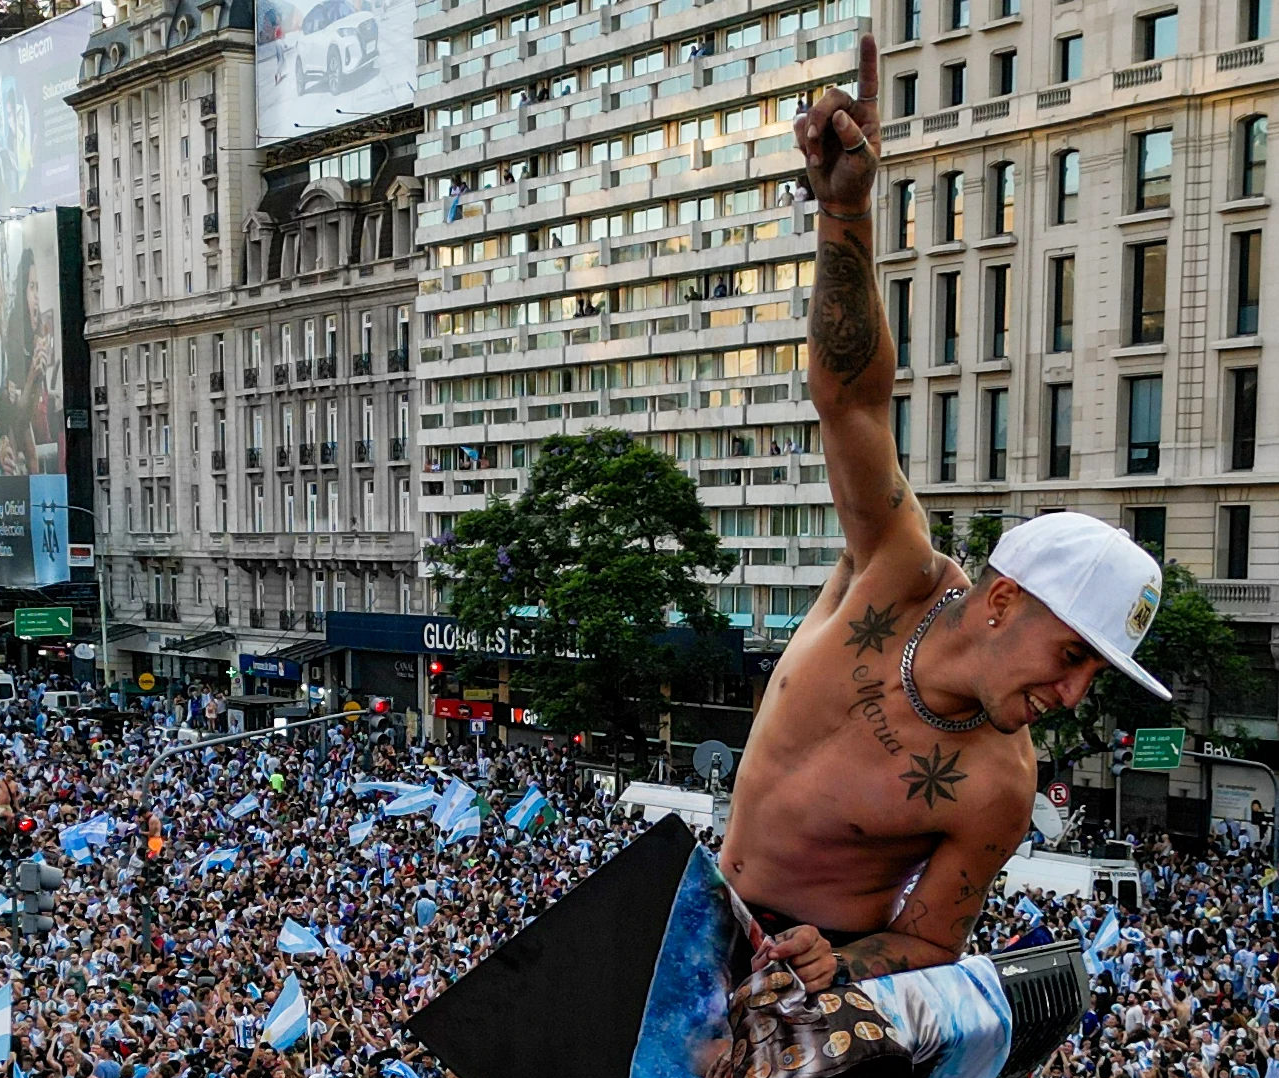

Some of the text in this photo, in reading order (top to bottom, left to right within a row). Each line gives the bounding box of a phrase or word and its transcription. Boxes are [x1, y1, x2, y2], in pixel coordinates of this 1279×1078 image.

[18, 35, 53, 65] telecom
[4, 500, 25, 516] Oficial
[846, 664, 904, 757] Maria
